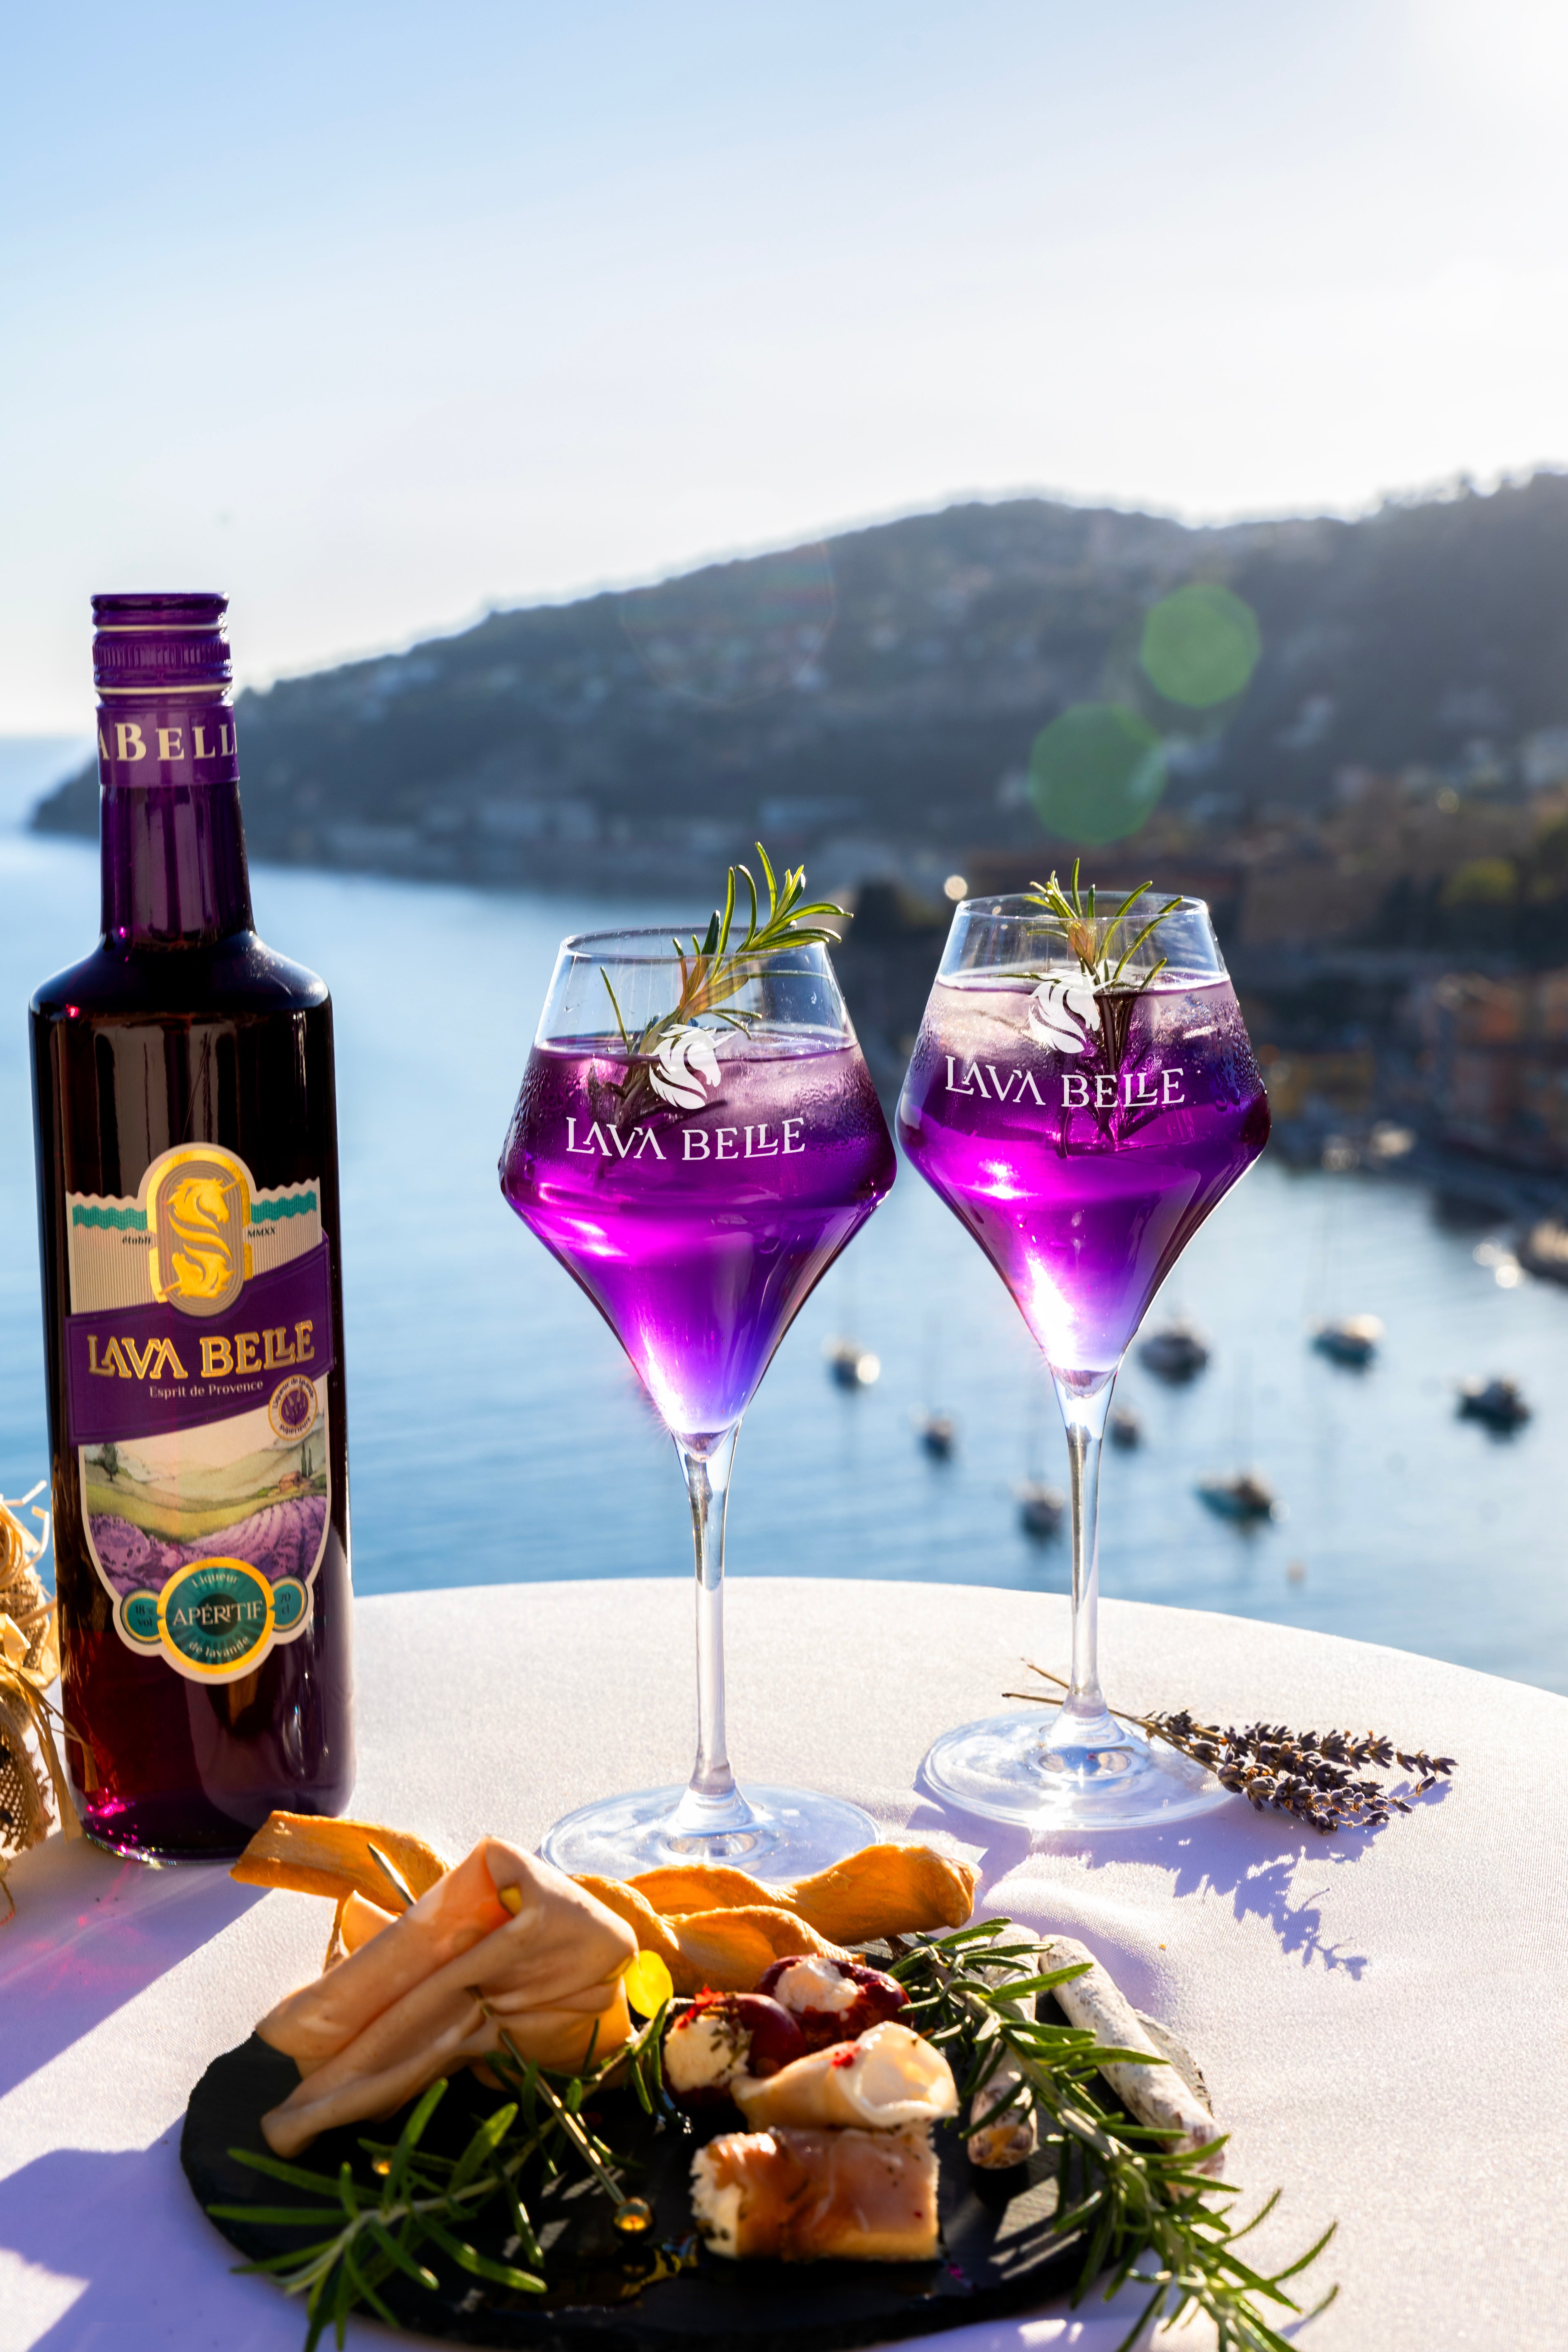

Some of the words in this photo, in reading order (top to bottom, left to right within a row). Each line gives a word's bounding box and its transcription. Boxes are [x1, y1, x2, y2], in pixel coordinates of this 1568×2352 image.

[945, 1055, 1046, 1105] LAVA
[1061, 1068, 1185, 1108] BELLE
[566, 1117, 667, 1160] LAVA
[682, 1117, 805, 1160] BELLE
[122, 1235, 151, 1245] établi
[247, 1226, 276, 1239] MMXX
[87, 1334, 188, 1380] LAVA
[200, 1320, 315, 1377] BELLE
[149, 1385, 187, 1400] Esprit
[190, 1384, 205, 1397] de
[208, 1380, 263, 1396] Provence
[192, 1573, 239, 1588] Liqueur
[135, 1604, 145, 1615] 18
[172, 1600, 263, 1626] APÉRITIF
[138, 1617, 152, 1628] vol
[189, 1641, 203, 1653] de
[205, 1637, 249, 1658] lavande
